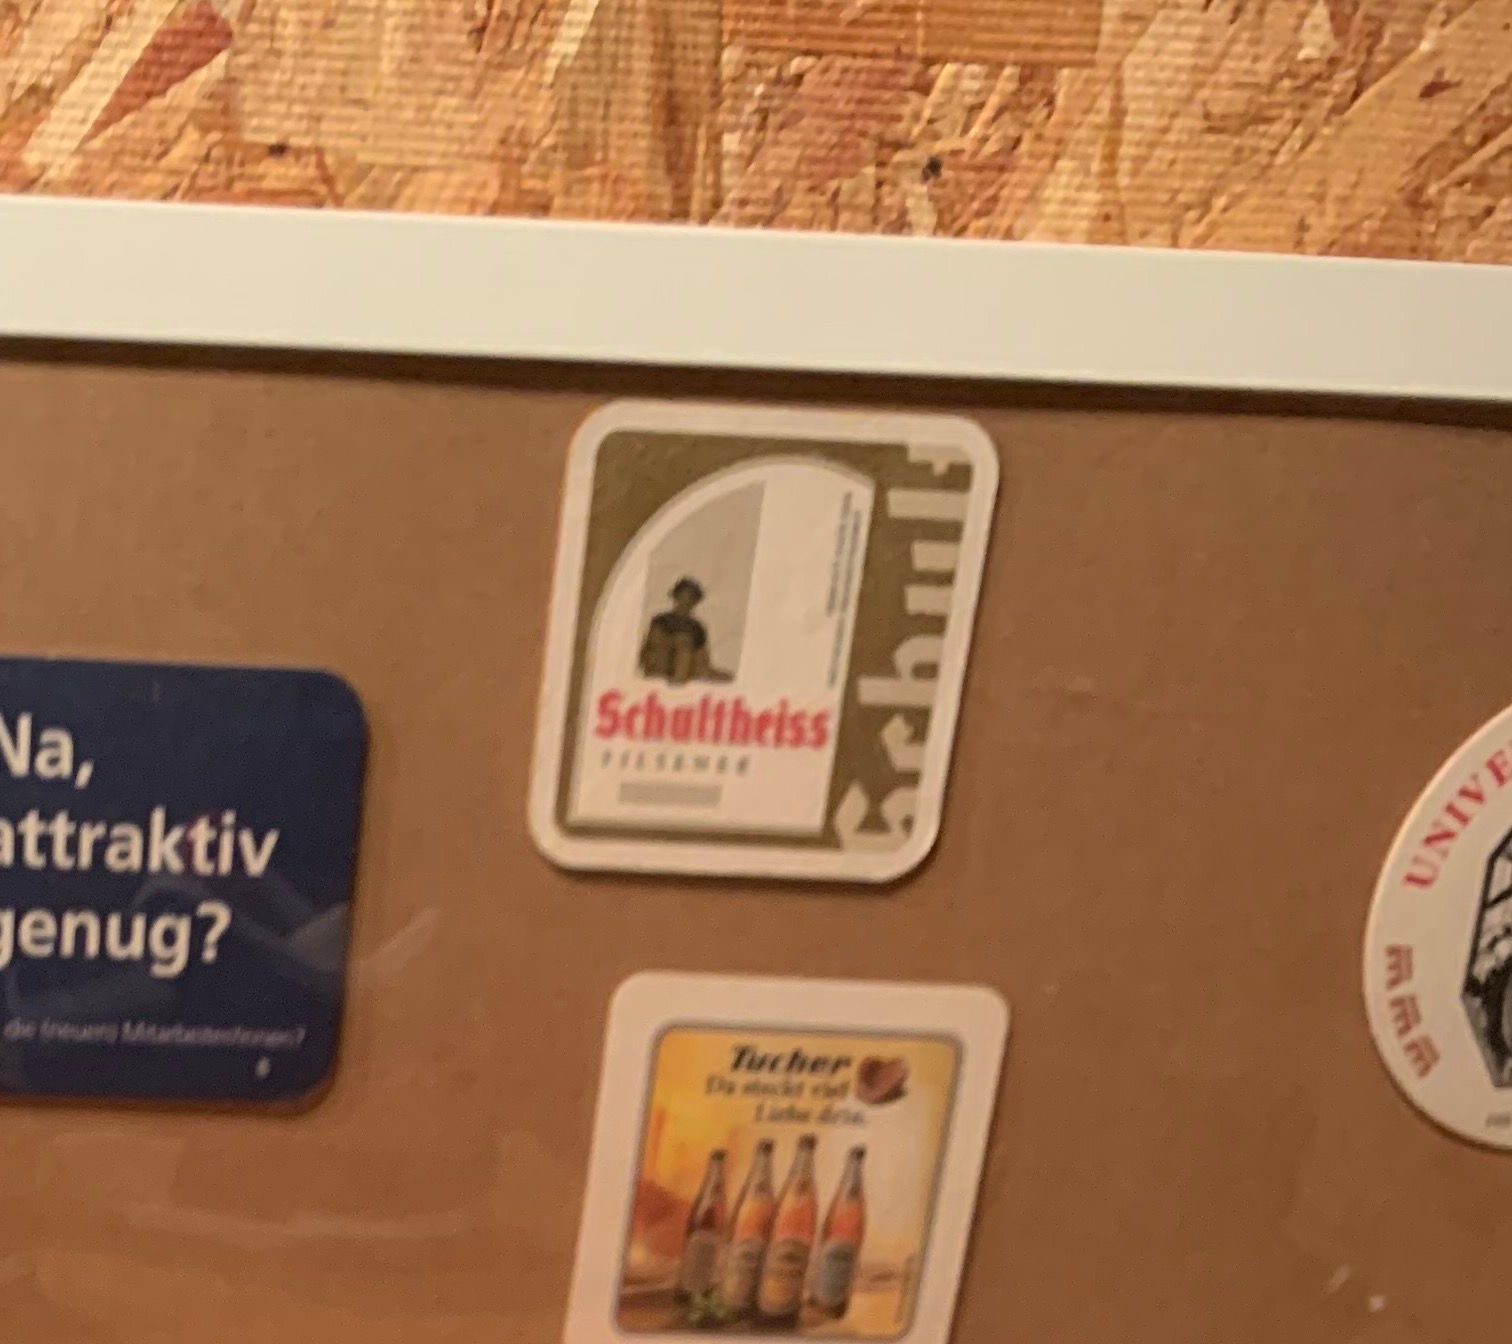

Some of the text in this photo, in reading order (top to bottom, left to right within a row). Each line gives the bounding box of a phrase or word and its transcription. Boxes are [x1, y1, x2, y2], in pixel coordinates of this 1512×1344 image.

[594, 688, 831, 750] Schultheiss
[1401, 738, 1512, 890] UNIVE
[731, 1044, 852, 1075] Tucher
